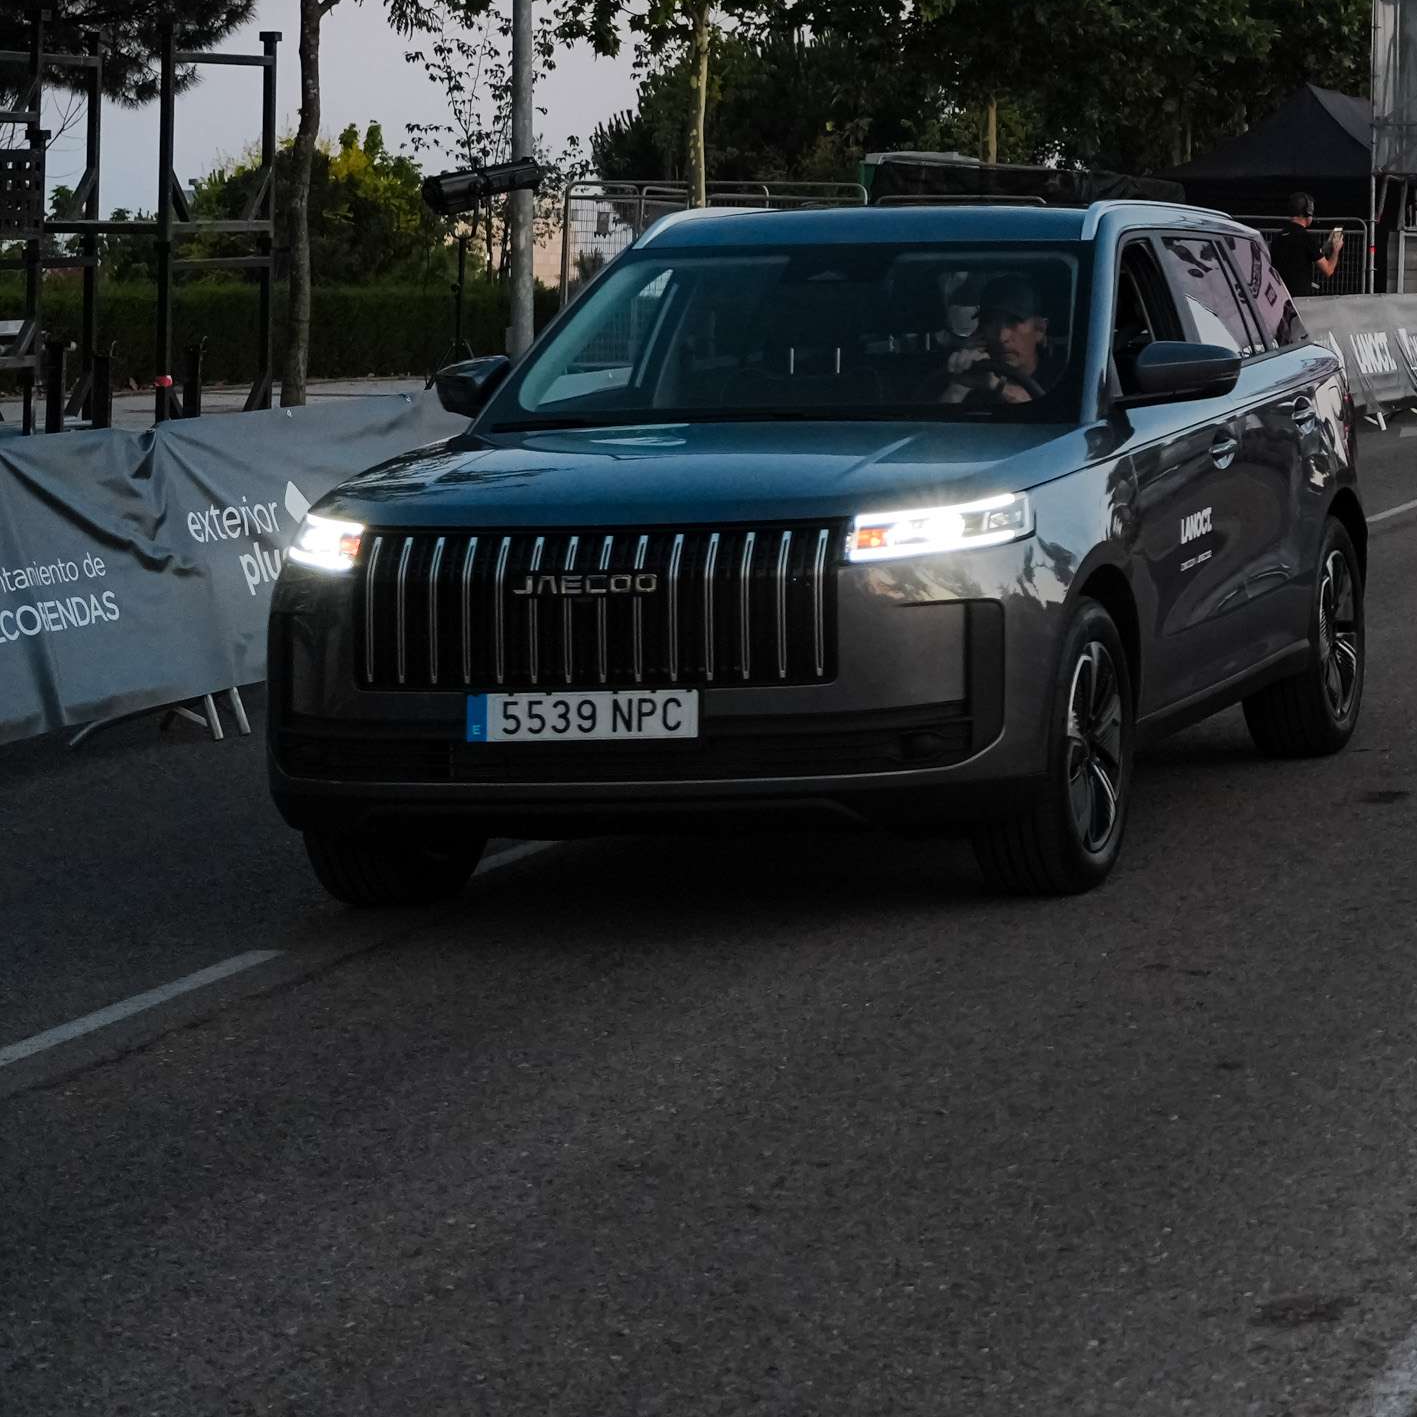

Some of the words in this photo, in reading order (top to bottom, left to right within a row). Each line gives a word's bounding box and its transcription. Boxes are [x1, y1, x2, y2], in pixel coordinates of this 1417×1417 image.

[82, 552, 107, 578] de
[239, 542, 289, 596] plu
[512, 573, 659, 595] JAECOO
[501, 699, 598, 735] 5539
[611, 697, 683, 733] NPC
